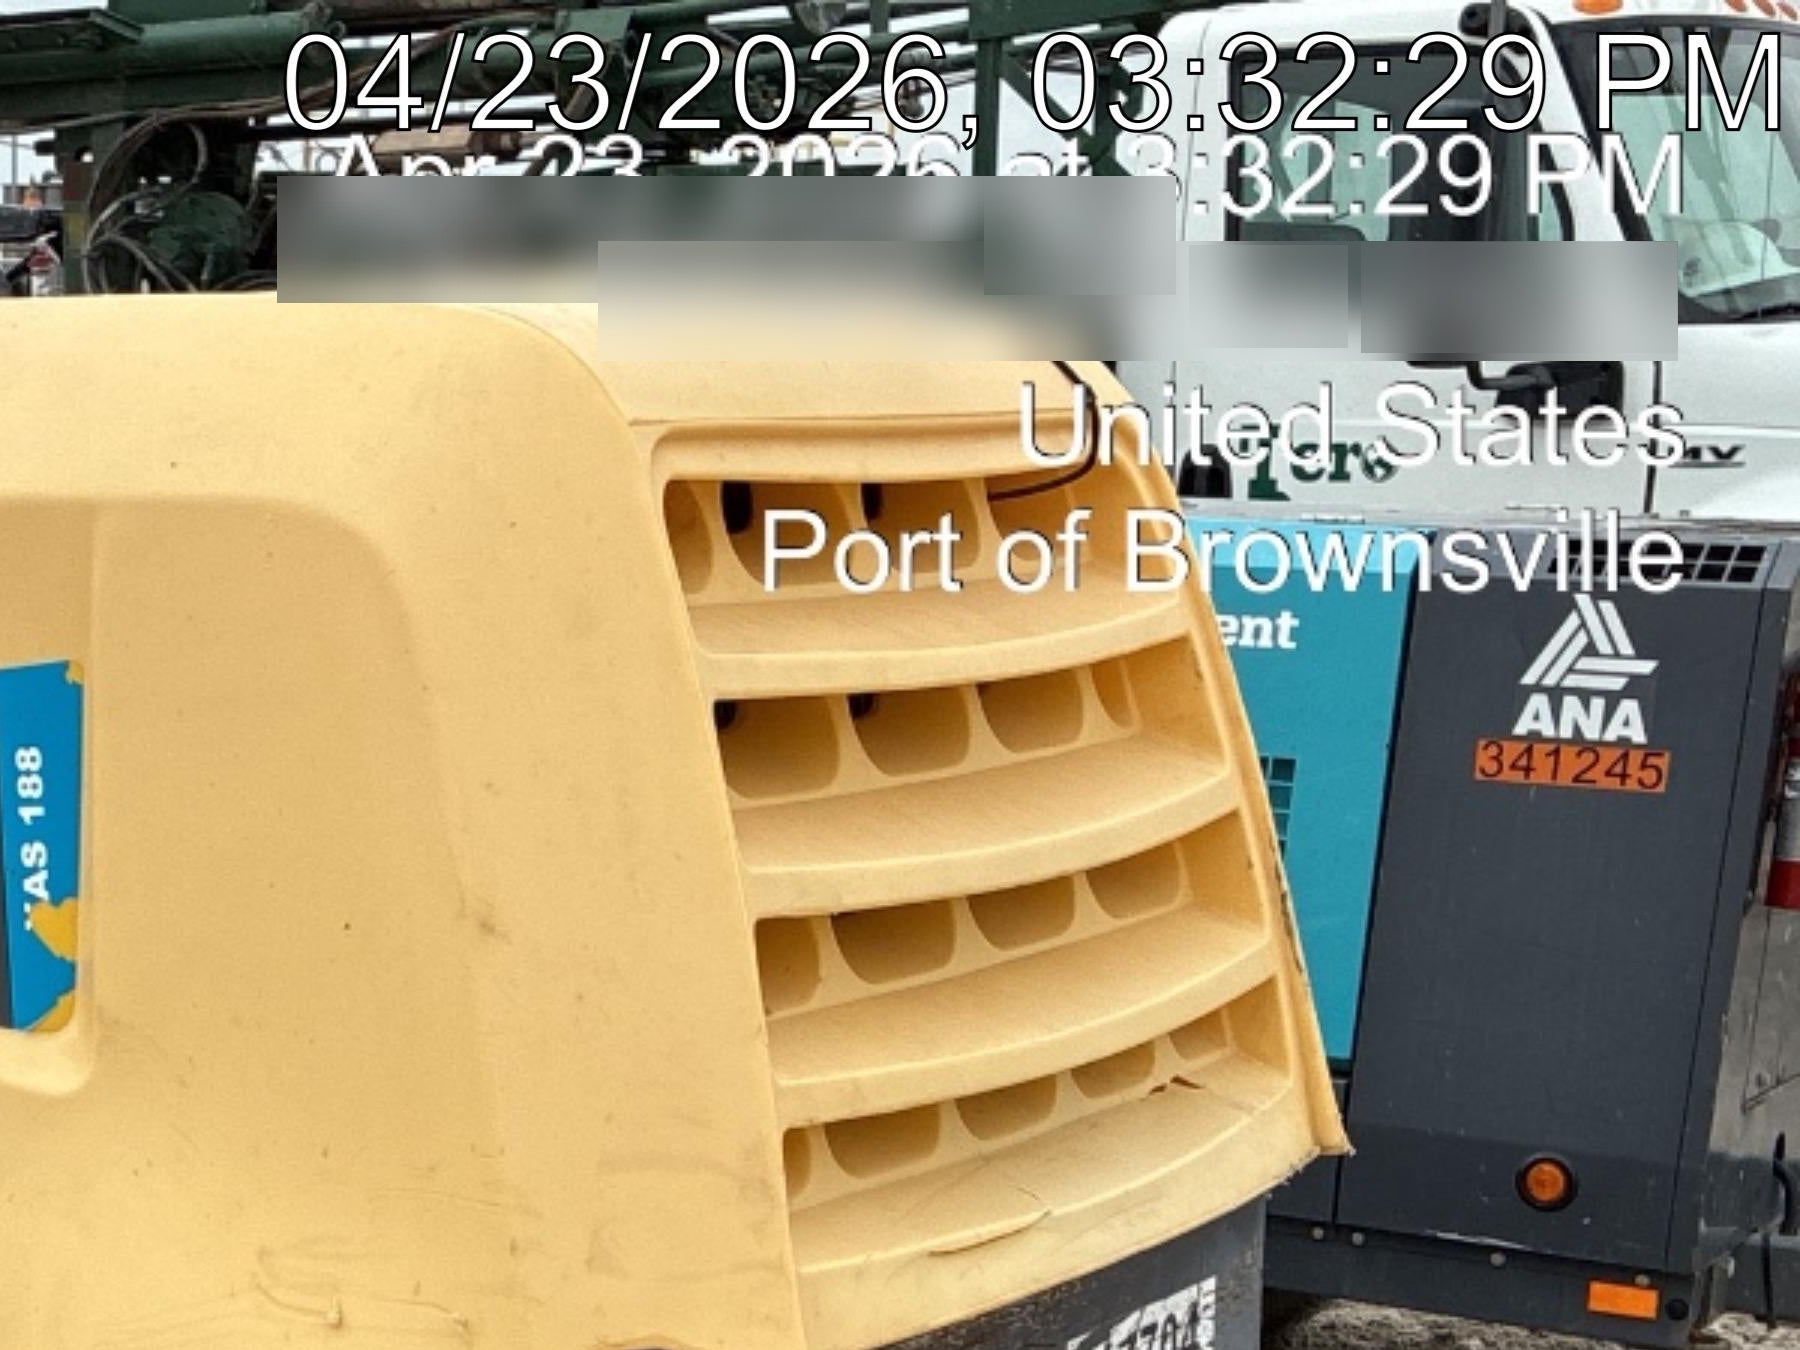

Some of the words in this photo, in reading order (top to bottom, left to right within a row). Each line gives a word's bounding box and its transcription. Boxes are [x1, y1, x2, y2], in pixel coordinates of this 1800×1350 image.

[1216, 609, 1300, 649] ent
[1512, 692, 1648, 745] ANA
[14, 745, 46, 826] 188
[1477, 739, 1666, 790] 341245
